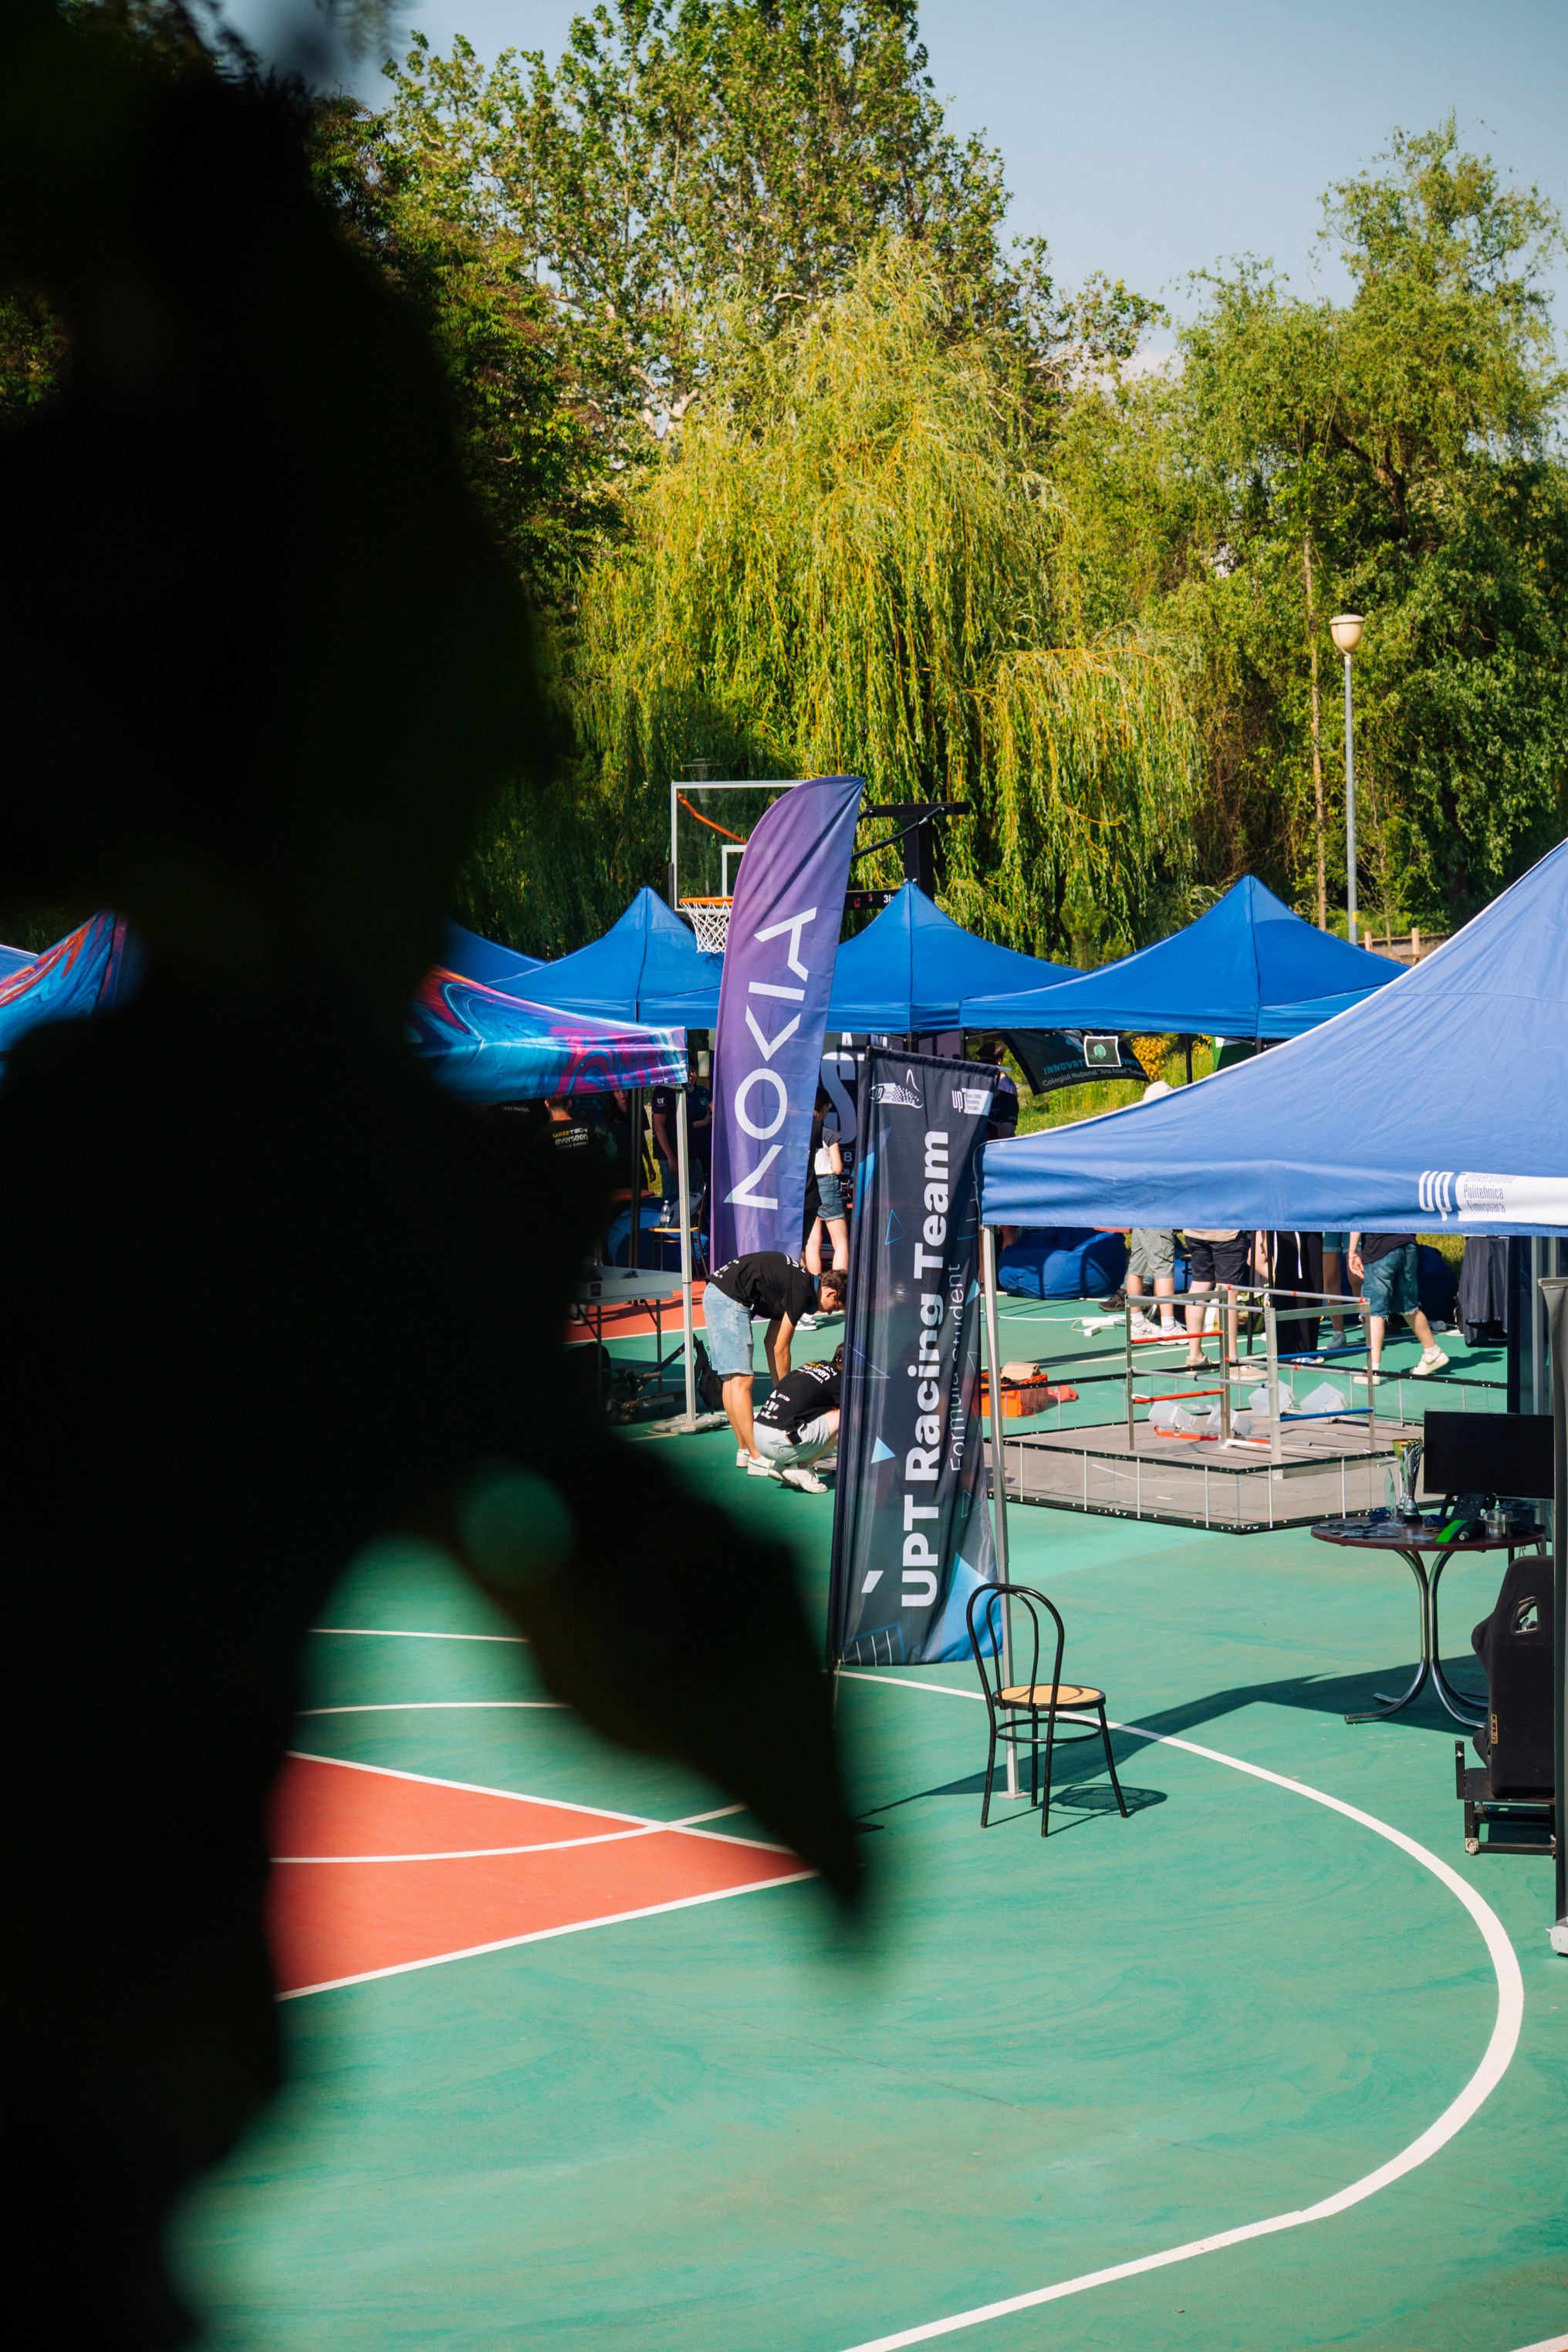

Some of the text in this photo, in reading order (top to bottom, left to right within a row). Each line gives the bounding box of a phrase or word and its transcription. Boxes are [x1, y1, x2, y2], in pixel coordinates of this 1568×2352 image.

[723, 907, 817, 1210] NOKIA
[1043, 1059, 1085, 1075] INNOVAT
[1043, 1073, 1072, 1086] Colegiul
[555, 1134, 588, 1145] everseen
[1463, 1184, 1505, 1200] Politehnica
[1465, 1200, 1506, 1214] Timișoara
[901, 1131, 949, 1607] UPT Racing Team
